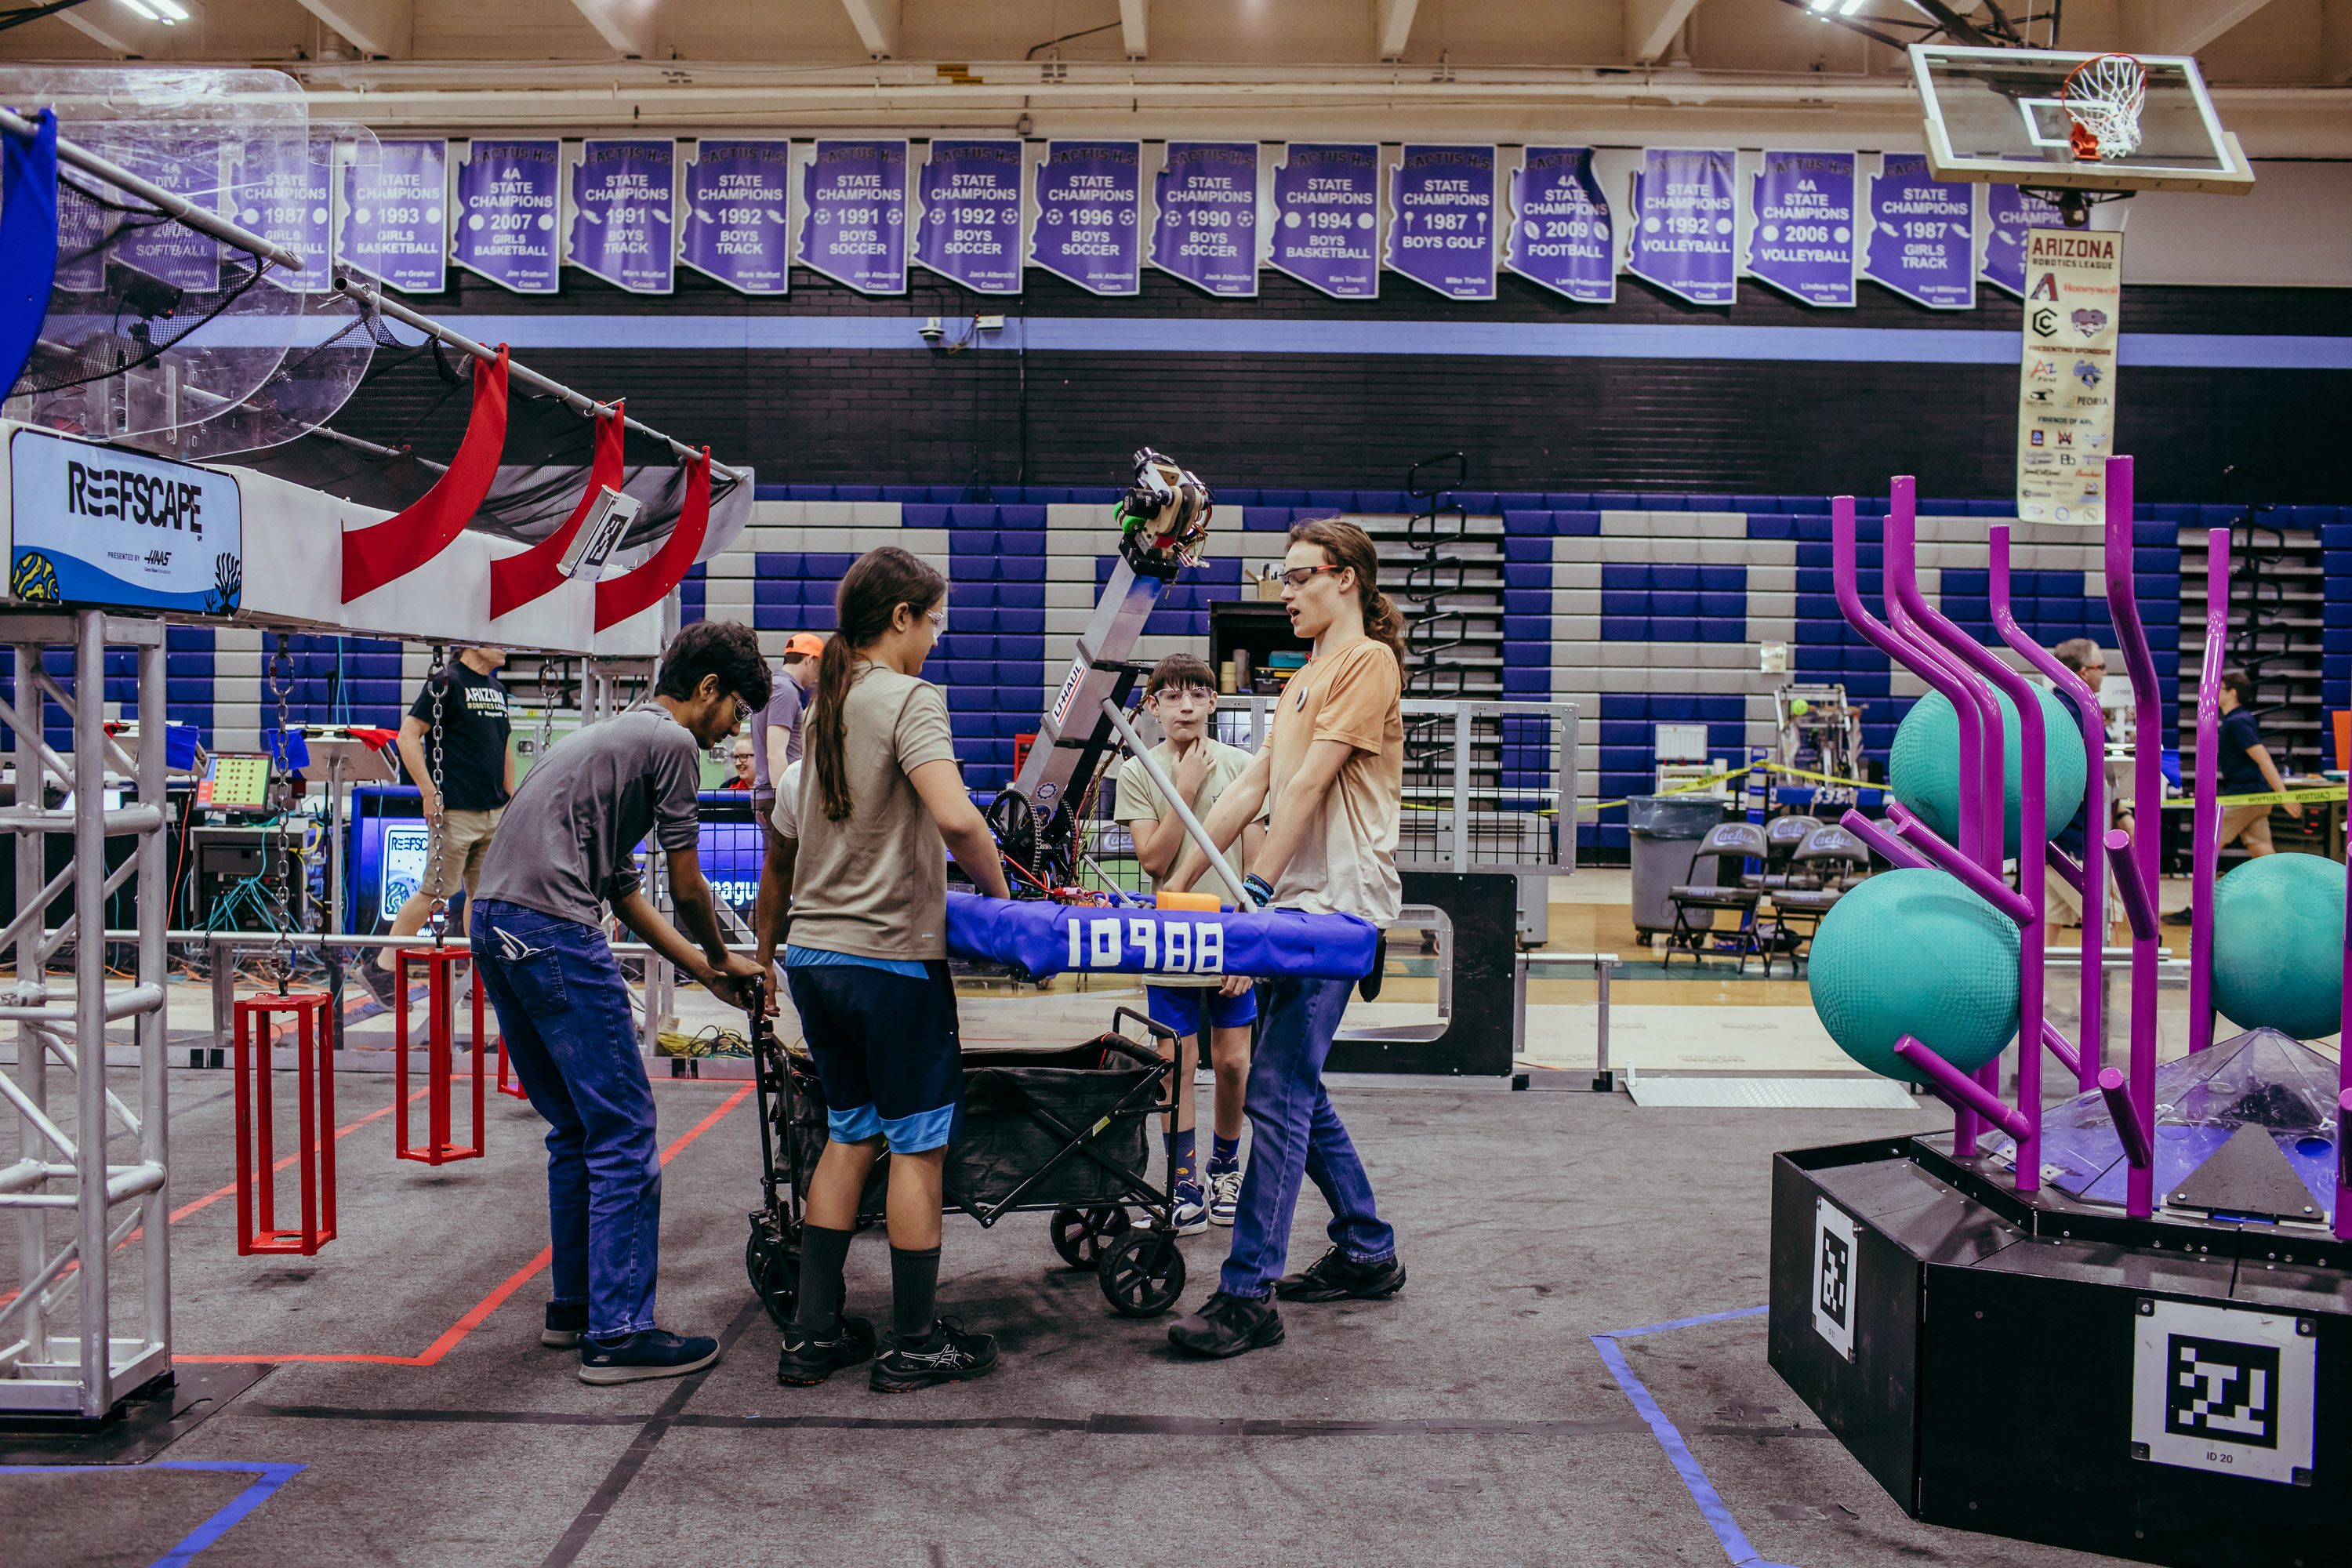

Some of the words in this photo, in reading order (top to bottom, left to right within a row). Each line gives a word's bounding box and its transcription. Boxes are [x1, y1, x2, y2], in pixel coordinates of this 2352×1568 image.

[471, 147, 528, 164] CACTUS
[586, 147, 643, 165] CACTUS
[700, 147, 757, 165] CACTUS
[818, 147, 876, 165] CACTUS
[933, 147, 991, 165] CACTUS
[1051, 148, 1109, 165] CACTUS
[1168, 150, 1227, 167] CACTUS
[1289, 151, 1347, 167] CACTUS
[1405, 152, 1463, 169] CACTUS
[266, 174, 307, 186] STATE
[378, 174, 420, 186] STATE
[503, 168, 521, 180] 4A
[952, 175, 996, 186] STATE
[606, 175, 648, 187] STATE
[719, 176, 762, 187] STATE
[837, 176, 880, 187] STATE
[1069, 176, 1114, 187] STATE
[1188, 176, 1232, 188] STATE
[1308, 178, 1352, 191] STATE
[1425, 180, 1468, 191] STATE
[1558, 175, 1577, 187] 4A
[1797, 180, 1817, 191] 4A
[245, 188, 326, 200] CHAMPIONS
[357, 188, 440, 200] CHAMPIONS
[490, 182, 533, 194] STATE
[585, 188, 668, 201] CHAMPIONS
[698, 188, 783, 200] CHAMPIONS
[816, 188, 902, 201] CHAMPIONS
[931, 188, 1016, 200] CHAMPIONS
[1666, 183, 1709, 196] STATE
[1904, 188, 1947, 201] STATE
[470, 195, 553, 207] CHAMPIONS
[1048, 190, 1134, 201] CHAMPIONS
[1167, 191, 1252, 202] CHAMPIONS
[1287, 192, 1373, 205] CHAMPIONS
[1403, 193, 1490, 205] CHAMPIONS
[1544, 189, 1589, 201] STATE
[1784, 194, 1829, 206] STATE
[1524, 202, 1608, 216] CHAMPIONS
[1645, 197, 1731, 210] CHAMPIONS
[1882, 201, 1969, 215] CHAMPIONS
[265, 208, 306, 223] 1987
[378, 208, 419, 223] 1993
[606, 208, 646, 223] 1991
[718, 209, 762, 224] 1992
[837, 209, 879, 224] 1991
[952, 208, 996, 224] 1992
[1069, 209, 1113, 225] 1996
[1187, 210, 1231, 227] 1990
[1308, 212, 1352, 228] 1994
[1763, 207, 1849, 220] CHAMPIONS
[491, 214, 532, 230] 2007
[1424, 213, 1468, 230] 1987
[1666, 218, 1709, 234] 1992
[265, 230, 301, 241] GIRLS
[377, 230, 414, 241] GIRLS
[608, 229, 644, 241] BOYS
[720, 230, 758, 241] BOYS
[839, 230, 877, 241] BOYS
[954, 230, 992, 241] BOYS
[1072, 230, 1109, 242] BOYS
[1545, 221, 1588, 238] 2009
[1784, 225, 1828, 242] 2006
[1903, 222, 1947, 239] 1987
[492, 234, 526, 244] GIRLS
[1189, 231, 1227, 243] BOYS
[1309, 235, 1345, 246] BOYS
[1403, 236, 1443, 248] BOYS
[1446, 236, 1486, 249] GOLF
[357, 242, 438, 254] BASKETBALL
[474, 245, 548, 256] BASKETBALL
[604, 241, 648, 253] TRACK
[716, 242, 763, 255] TRACK
[829, 243, 887, 255] SOCCER
[945, 242, 1002, 254] SOCCER
[1062, 243, 1120, 256] SOCCER
[1180, 245, 1237, 256] SOCCER
[1528, 244, 1604, 258] FOOTBALL
[1642, 239, 1731, 253] VOLLEYBALL
[1904, 244, 1945, 256] GIRLS
[2032, 238, 2114, 259] ARIZONA
[1286, 247, 1370, 259] BASKETBALL
[1762, 249, 1850, 263] VOLLEYBALL
[1901, 256, 1948, 269] TRACK
[2032, 258, 2077, 267] ROBOTICS
[2079, 260, 2114, 270] LEAGUE
[2078, 396, 2108, 405] PEORIA
[68, 460, 202, 534] REEFSCAPE
[107, 551, 133, 561] PRESENTED
[144, 550, 172, 566] HAAS
[464, 687, 505, 705] ARIZON
[1054, 666, 1082, 717] U-HAUL
[1712, 824, 1755, 847] Cactus
[1809, 828, 1853, 851] Cactus
[392, 837, 428, 851] REEFSC
[1067, 916, 1225, 975] 10988
[2206, 1451, 2217, 1461] ID
[2220, 1453, 2234, 1464] 20
